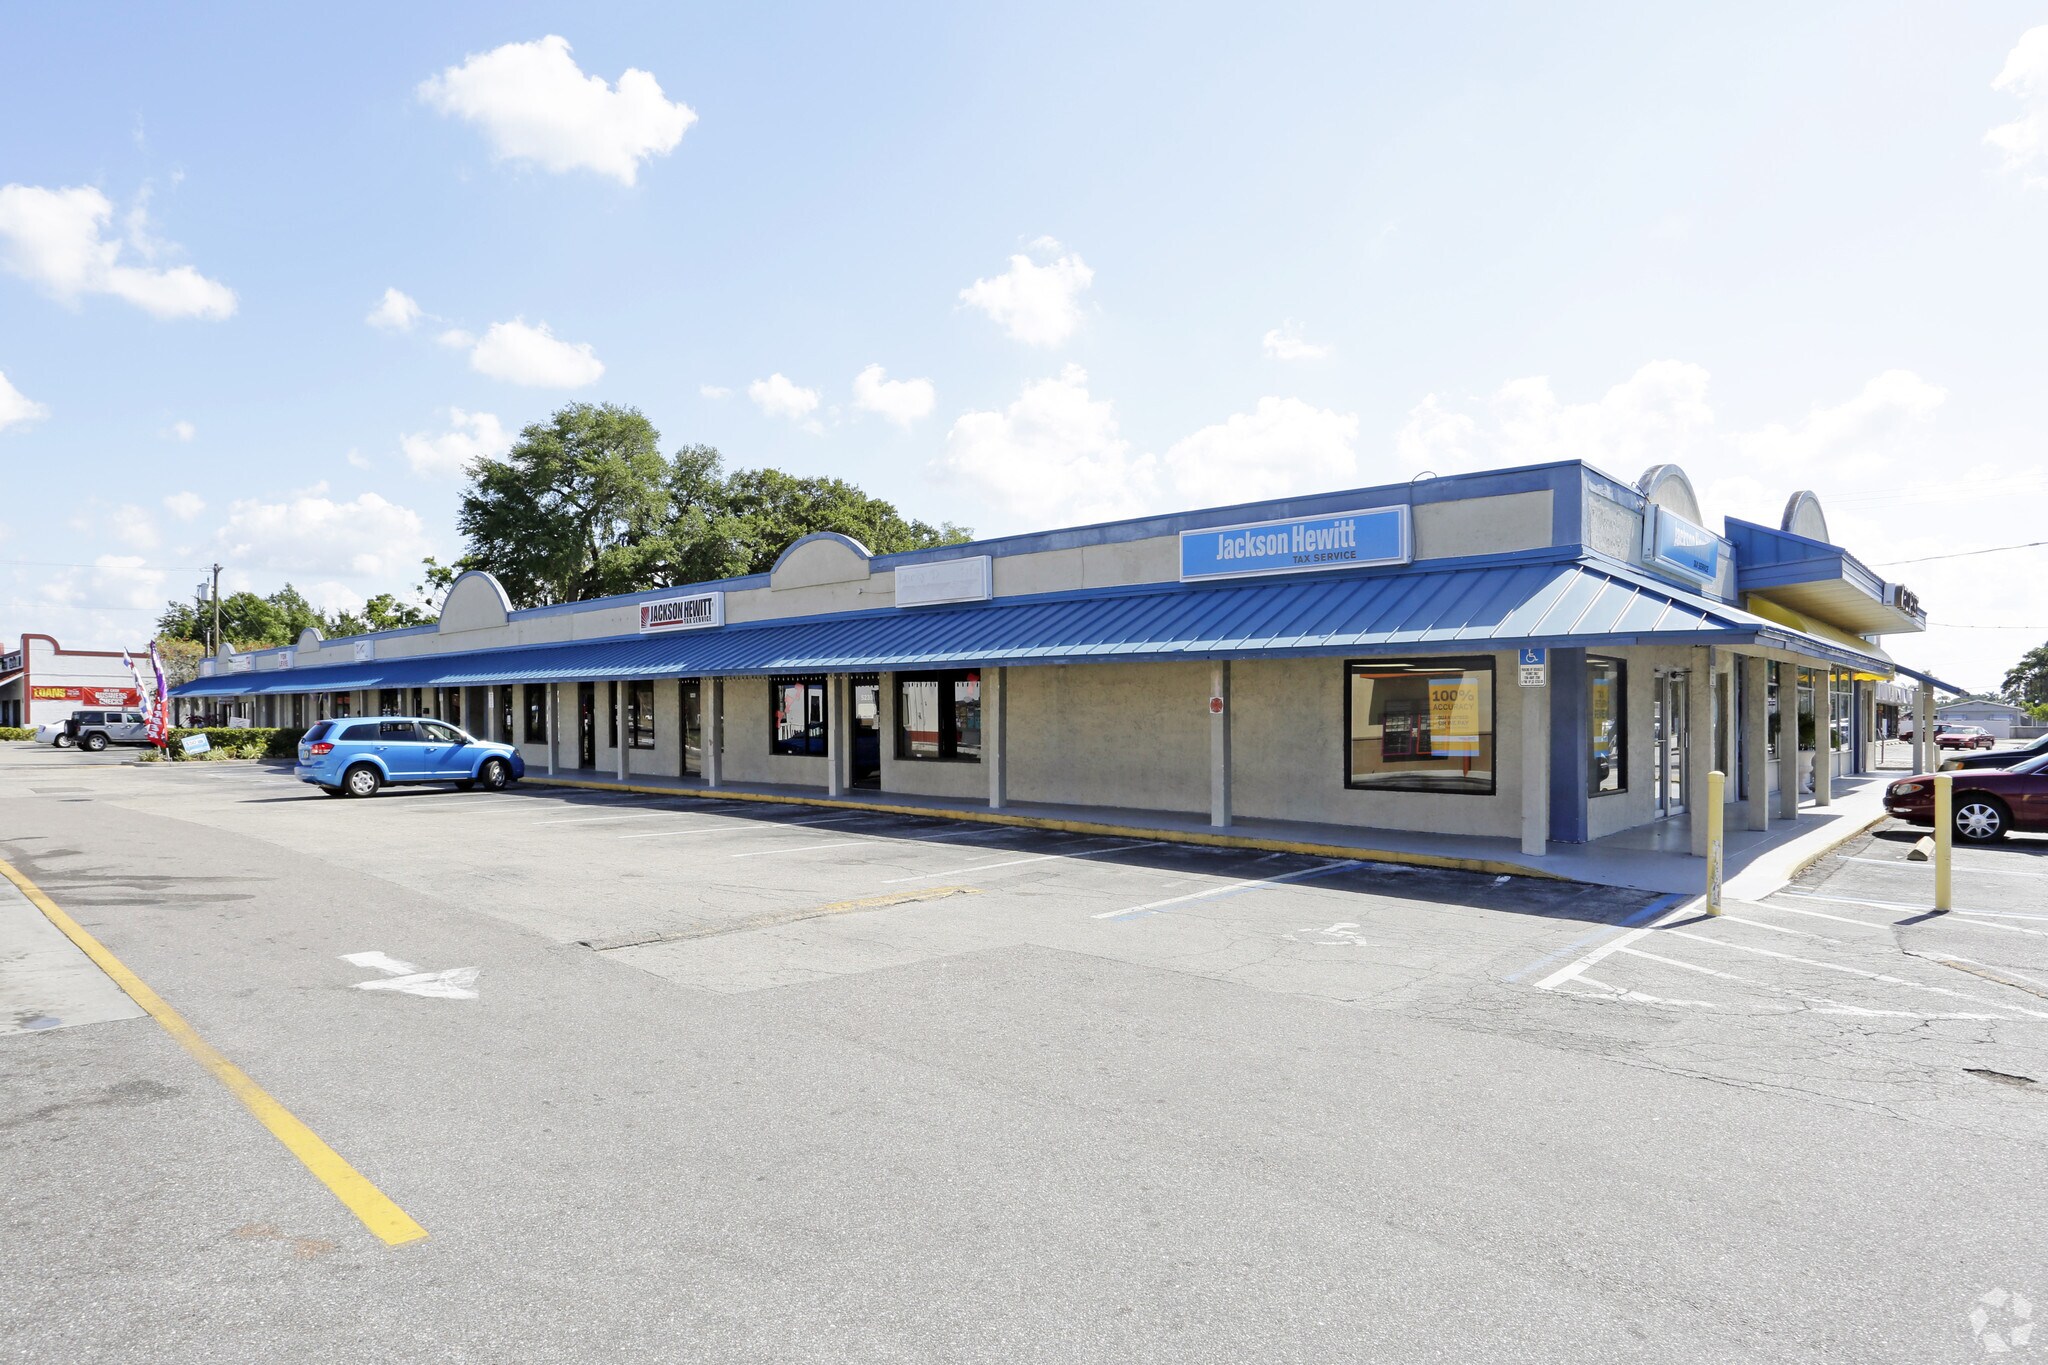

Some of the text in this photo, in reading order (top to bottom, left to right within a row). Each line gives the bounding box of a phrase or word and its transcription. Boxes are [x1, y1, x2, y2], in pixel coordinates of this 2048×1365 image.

[1216, 519, 1356, 560] Jackson Hewitt
[1293, 550, 1357, 564] TAX SERVICE
[650, 597, 712, 622] JACKSON HEWITT
[684, 615, 712, 624] TAX SERVICE
[33, 688, 66, 698] LOANS
[1432, 690, 1475, 702] 100%
[1433, 703, 1474, 711] ACCURACY
